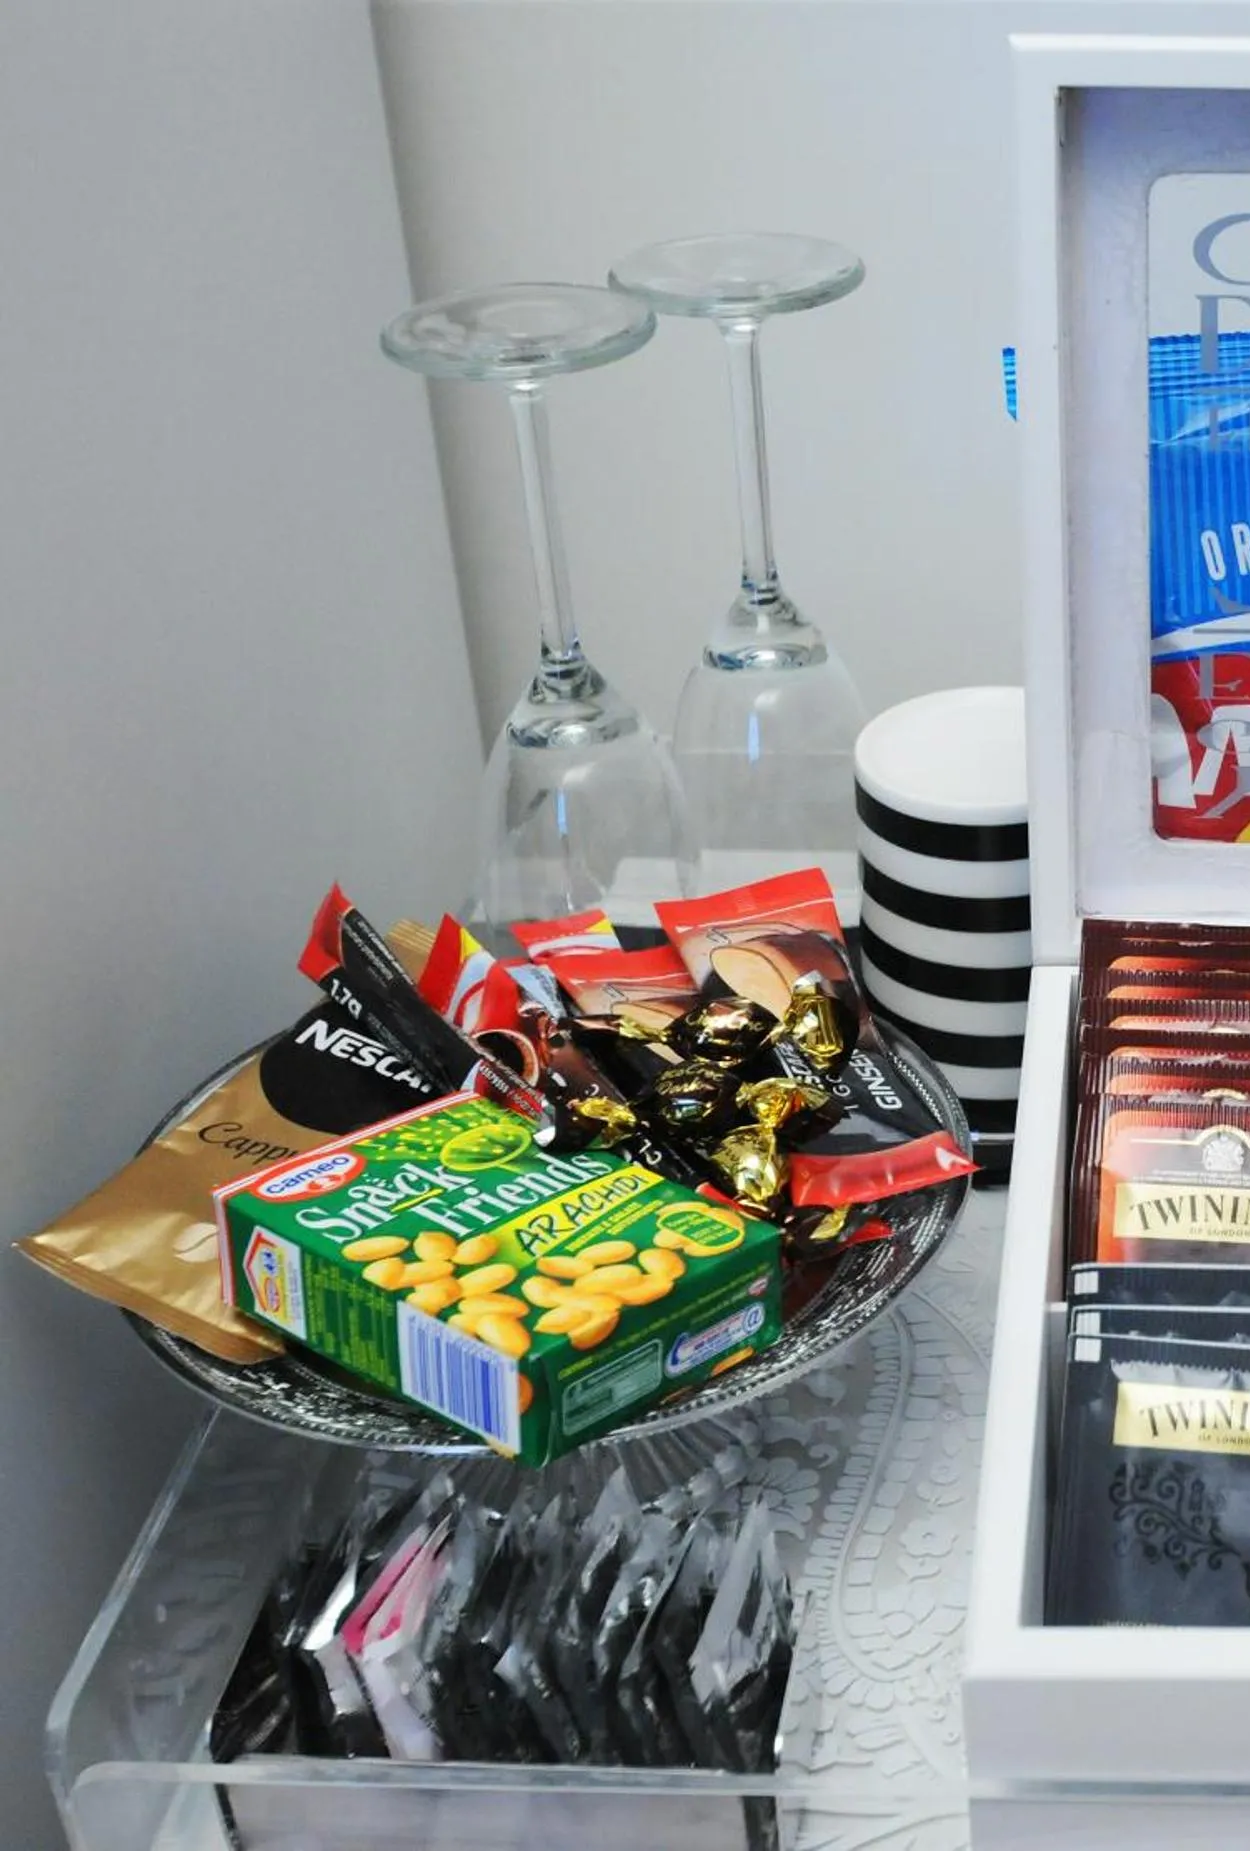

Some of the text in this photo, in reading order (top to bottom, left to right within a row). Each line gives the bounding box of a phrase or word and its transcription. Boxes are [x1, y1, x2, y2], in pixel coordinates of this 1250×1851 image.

[266, 1156, 350, 1194] cameo
[295, 1162, 477, 1244] Snack
[410, 1152, 613, 1237] Friends
